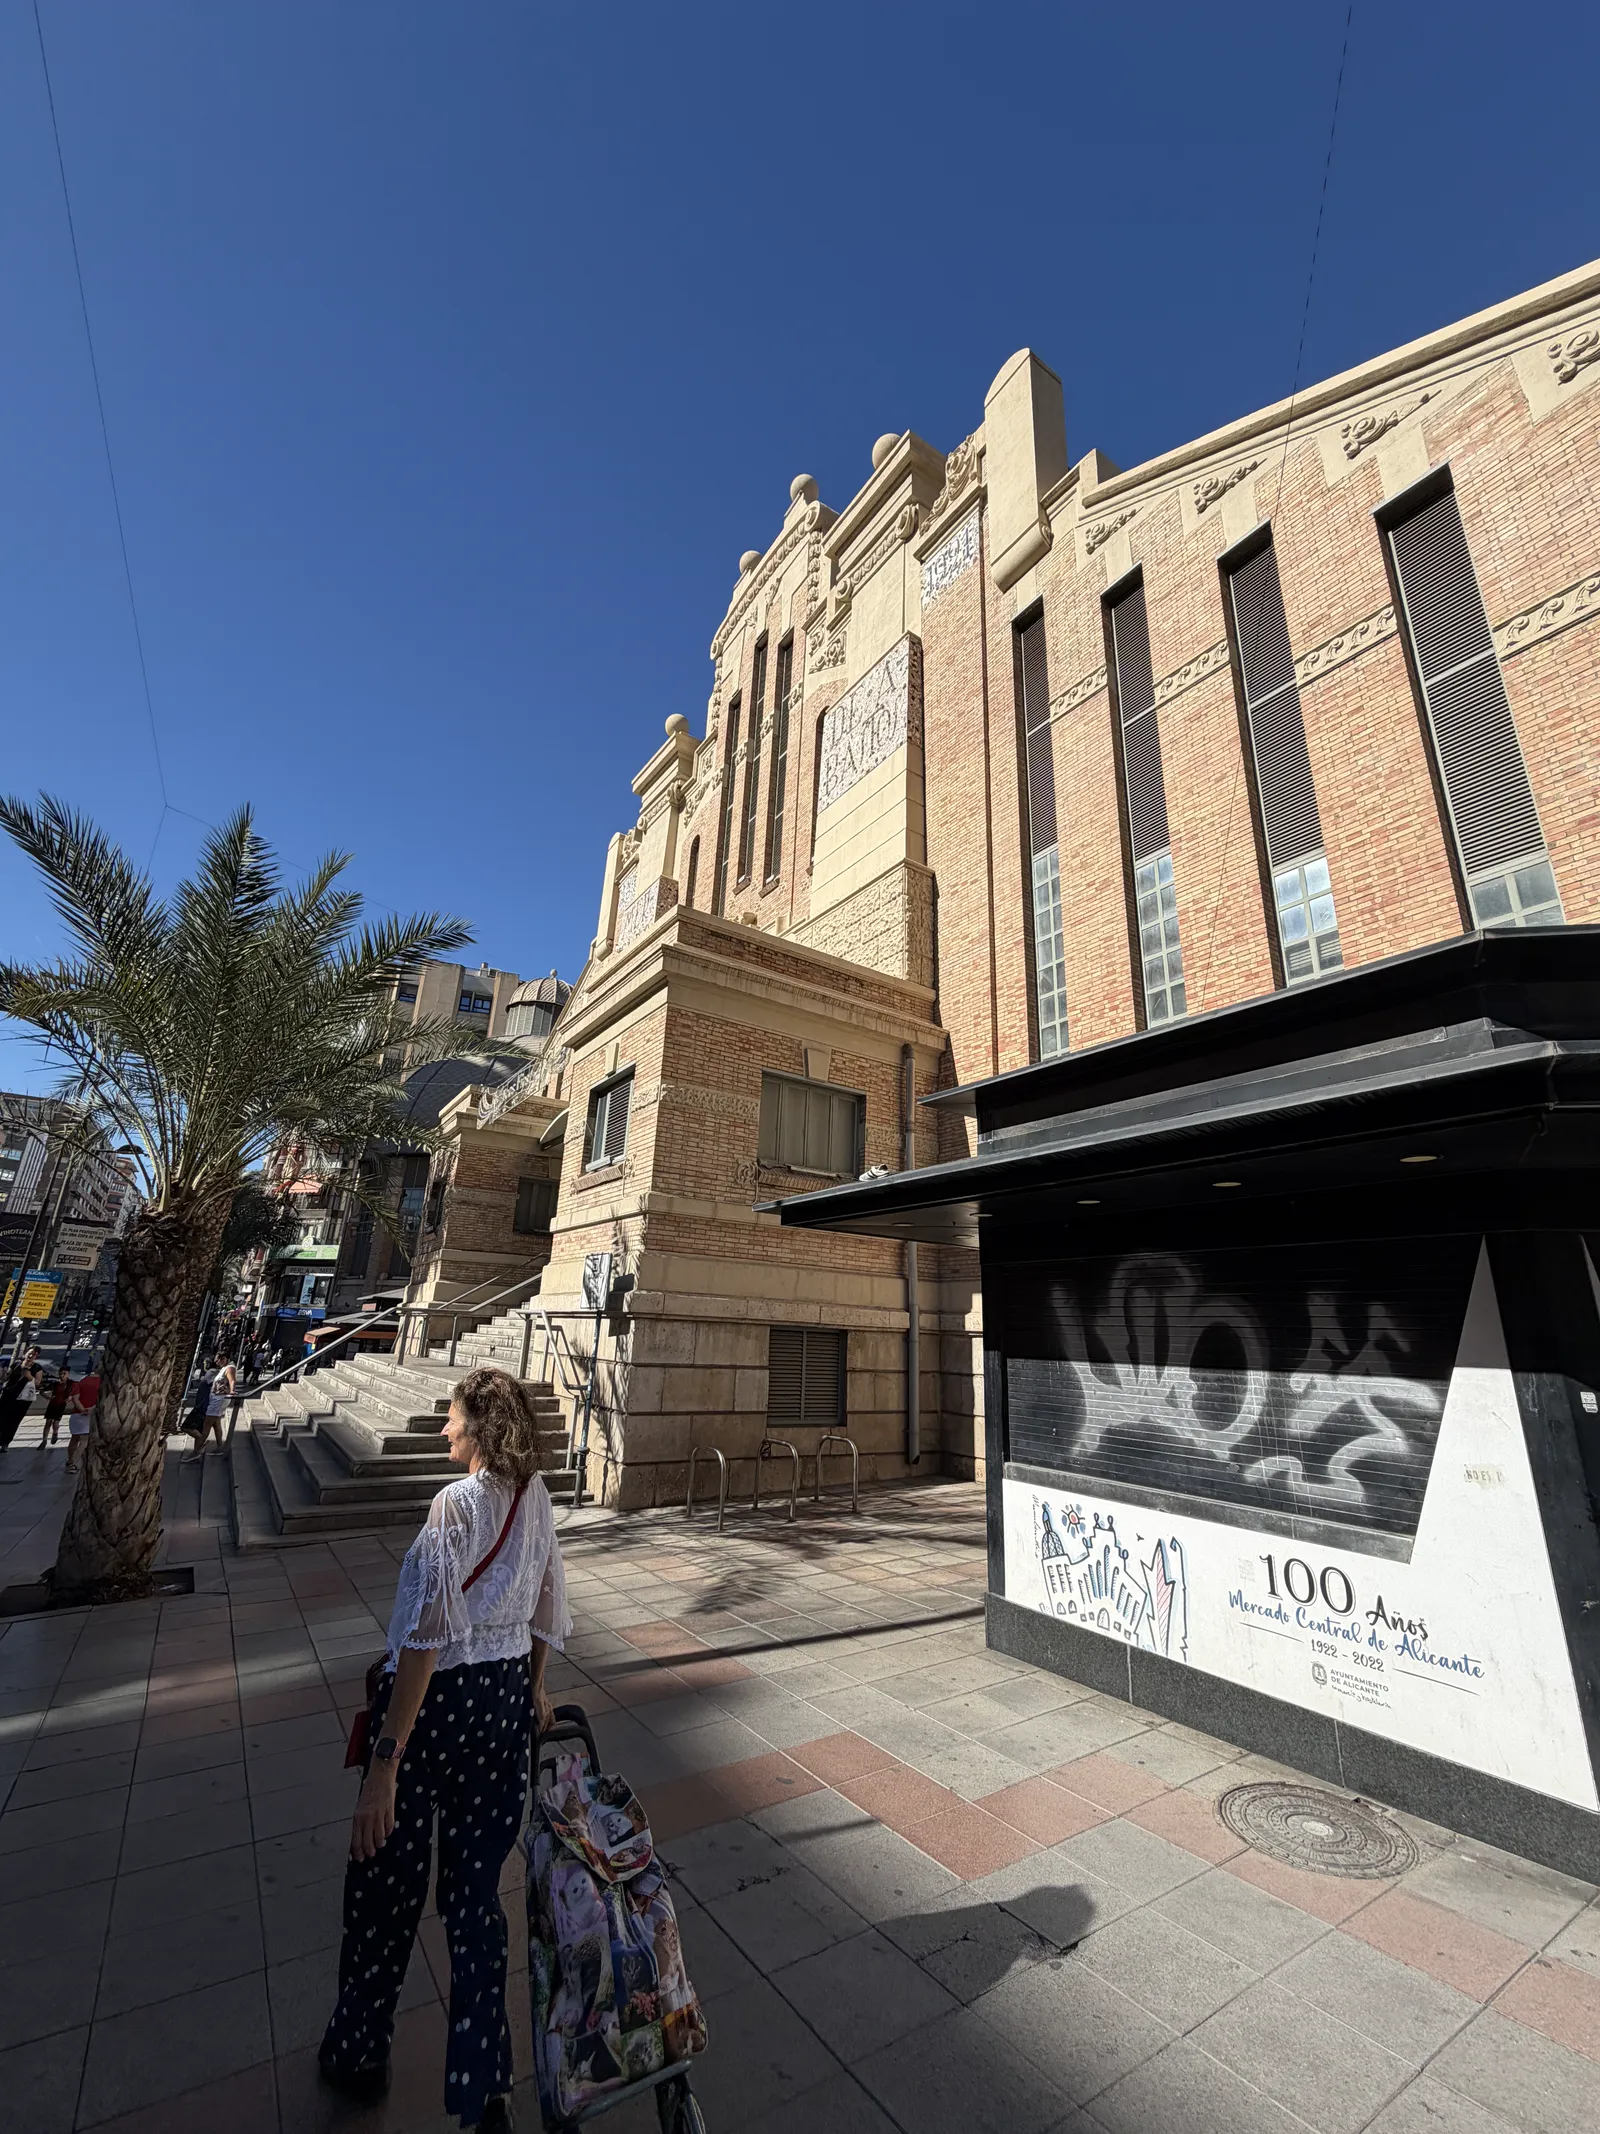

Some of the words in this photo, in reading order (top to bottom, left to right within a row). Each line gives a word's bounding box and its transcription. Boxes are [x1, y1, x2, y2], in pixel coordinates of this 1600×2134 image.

[1259, 1554, 1357, 1617] 100
[1365, 1595, 1429, 1640] Años
[1228, 1589, 1291, 1625] Mercado
[1295, 1606, 1362, 1644] Central
[1368, 1631, 1388, 1652] de
[1394, 1634, 1485, 1679] Alicante
[1310, 1639, 1338, 1658] 1922
[1352, 1651, 1385, 1673] 2022
[1330, 1669, 1389, 1692] AYUNTAMIENTO
[1330, 1676, 1341, 1684] DE
[1343, 1681, 1380, 1697] ALICANTE
